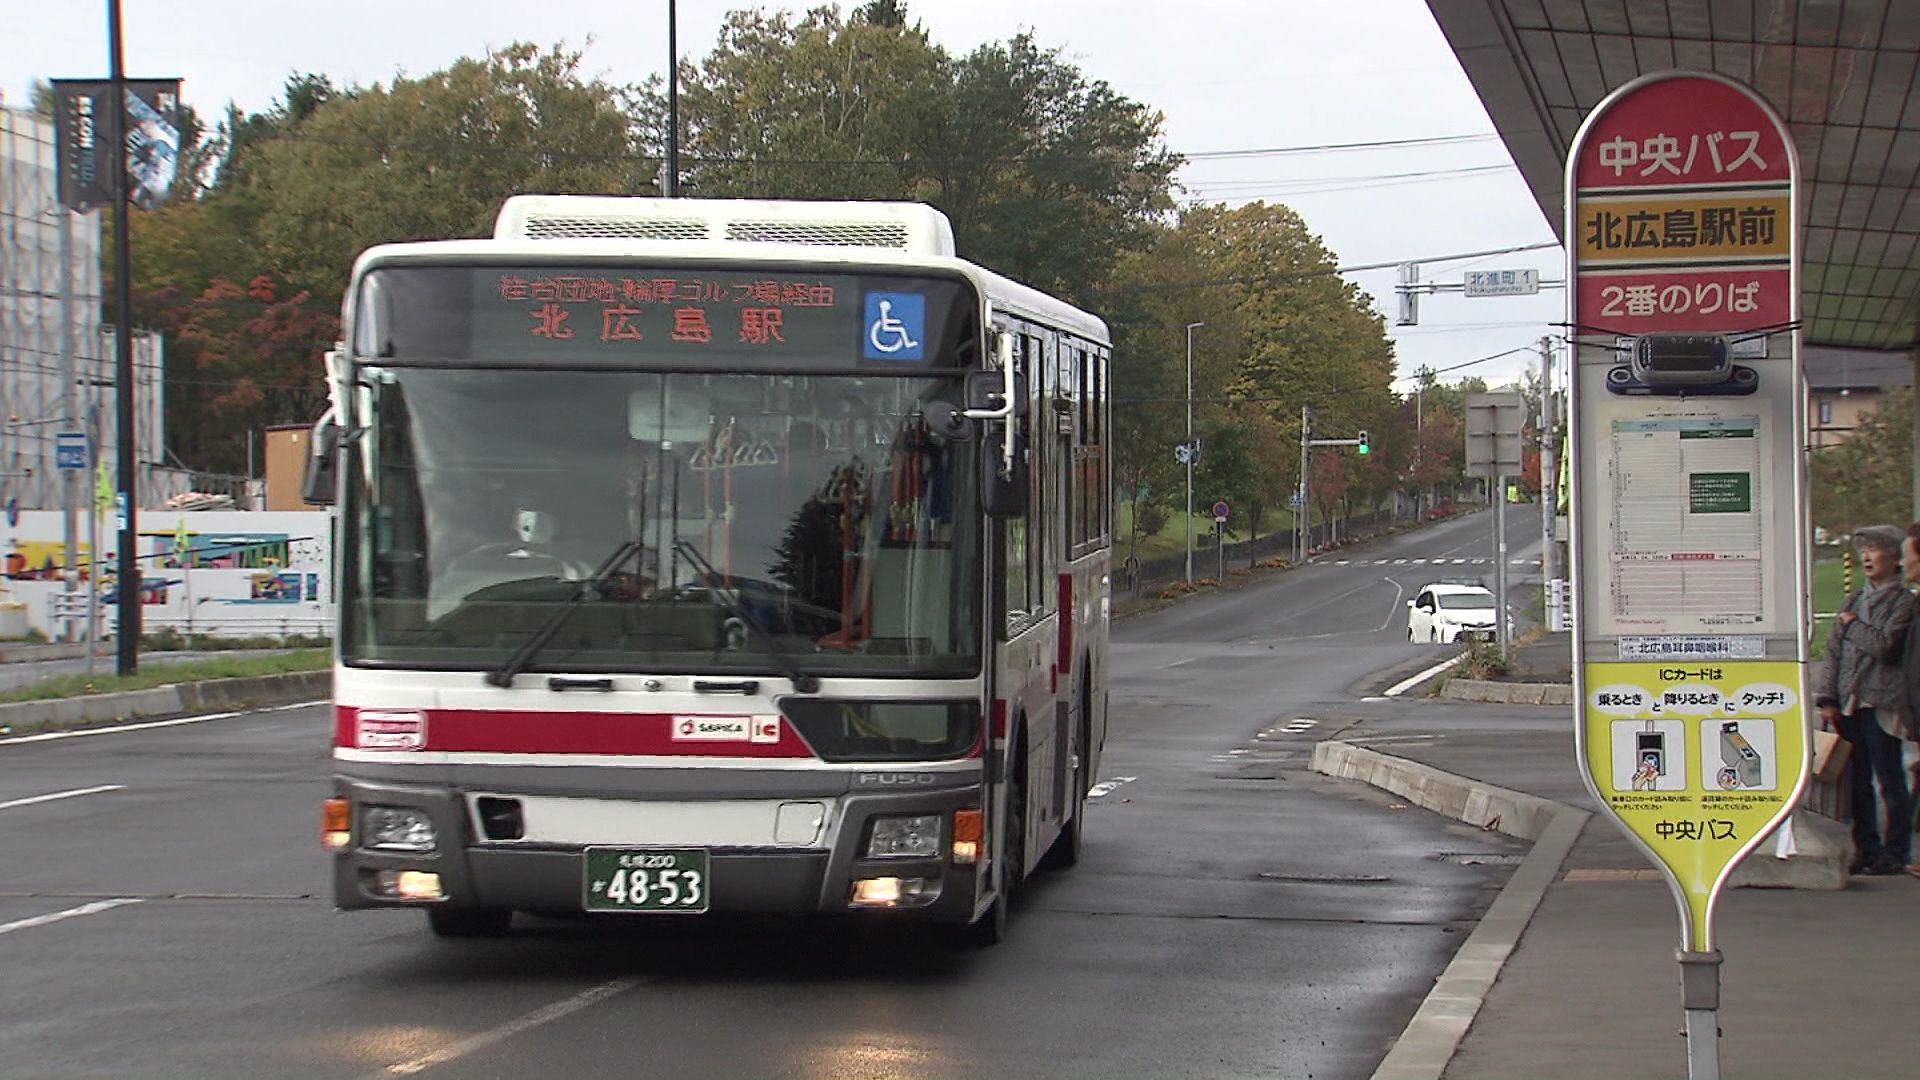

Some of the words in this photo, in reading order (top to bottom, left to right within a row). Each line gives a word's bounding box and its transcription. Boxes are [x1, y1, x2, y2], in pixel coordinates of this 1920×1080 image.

[1599, 130, 1767, 177] 中央バス
[1586, 206, 1776, 249] 北広島駅前
[1601, 281, 1760, 317] 2番のりば
[530, 303, 786, 344] 北広島駅
[1659, 668, 1724, 681] ICカードは
[860, 773, 935, 785] FUSO
[1655, 819, 1737, 841] 中央バス
[607, 869, 701, 905] 48-53
